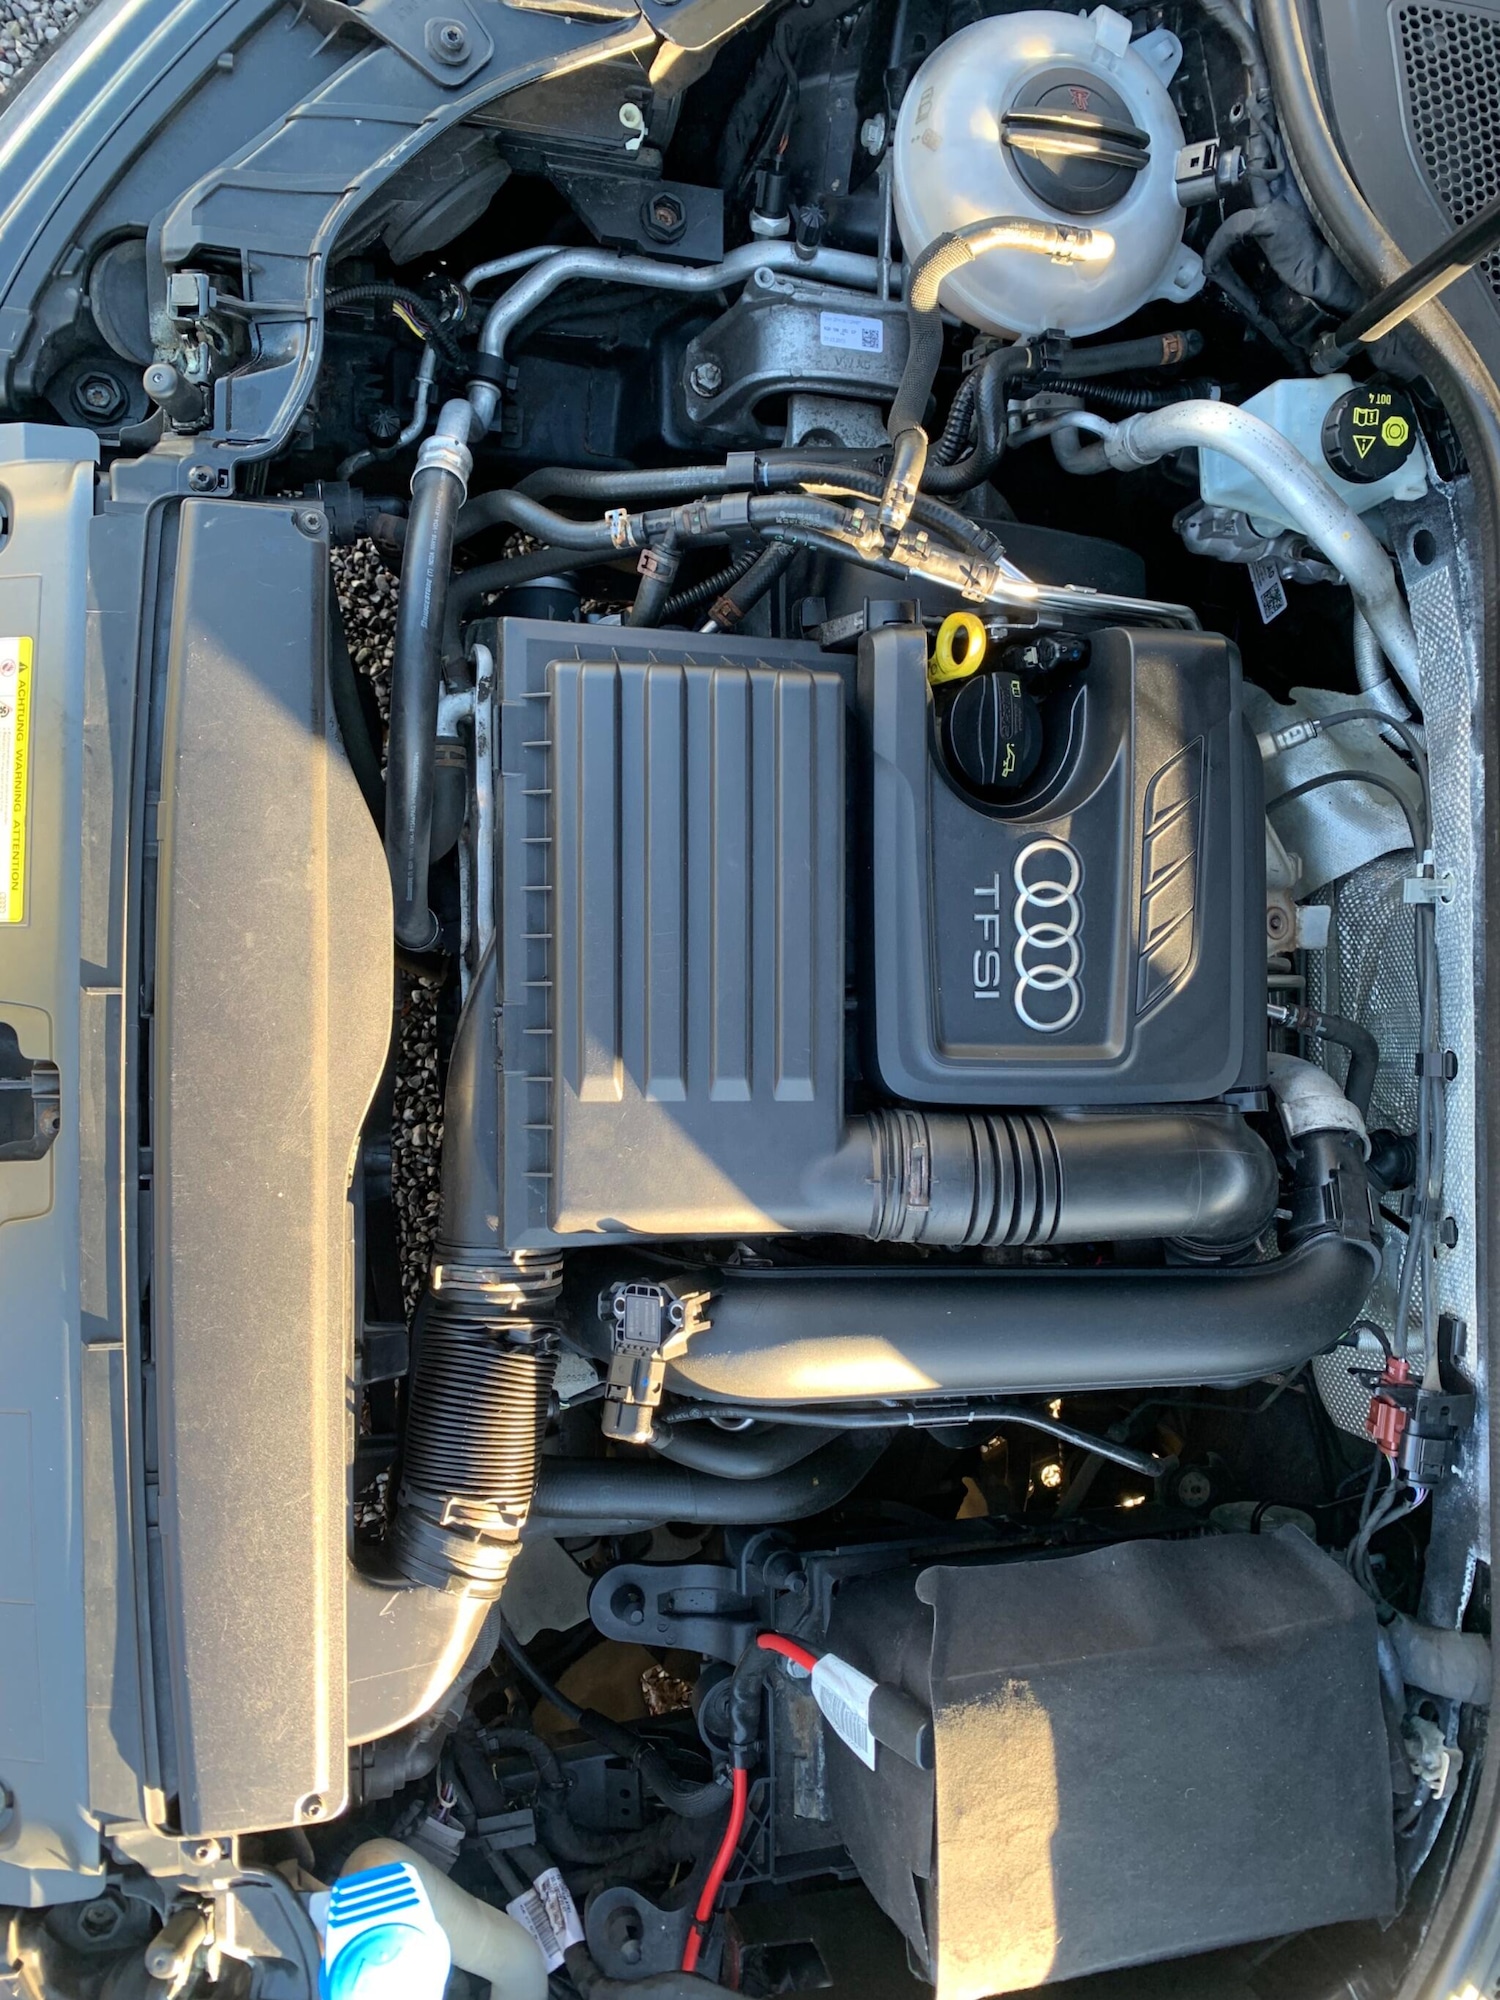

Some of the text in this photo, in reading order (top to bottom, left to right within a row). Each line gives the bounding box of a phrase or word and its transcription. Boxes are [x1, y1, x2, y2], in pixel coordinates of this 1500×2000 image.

[1369, 393, 1391, 405] DOT 4
[12, 680, 27, 891] ACHTUNG WARNING ATTENTION
[973, 873, 1000, 999] TFSI
